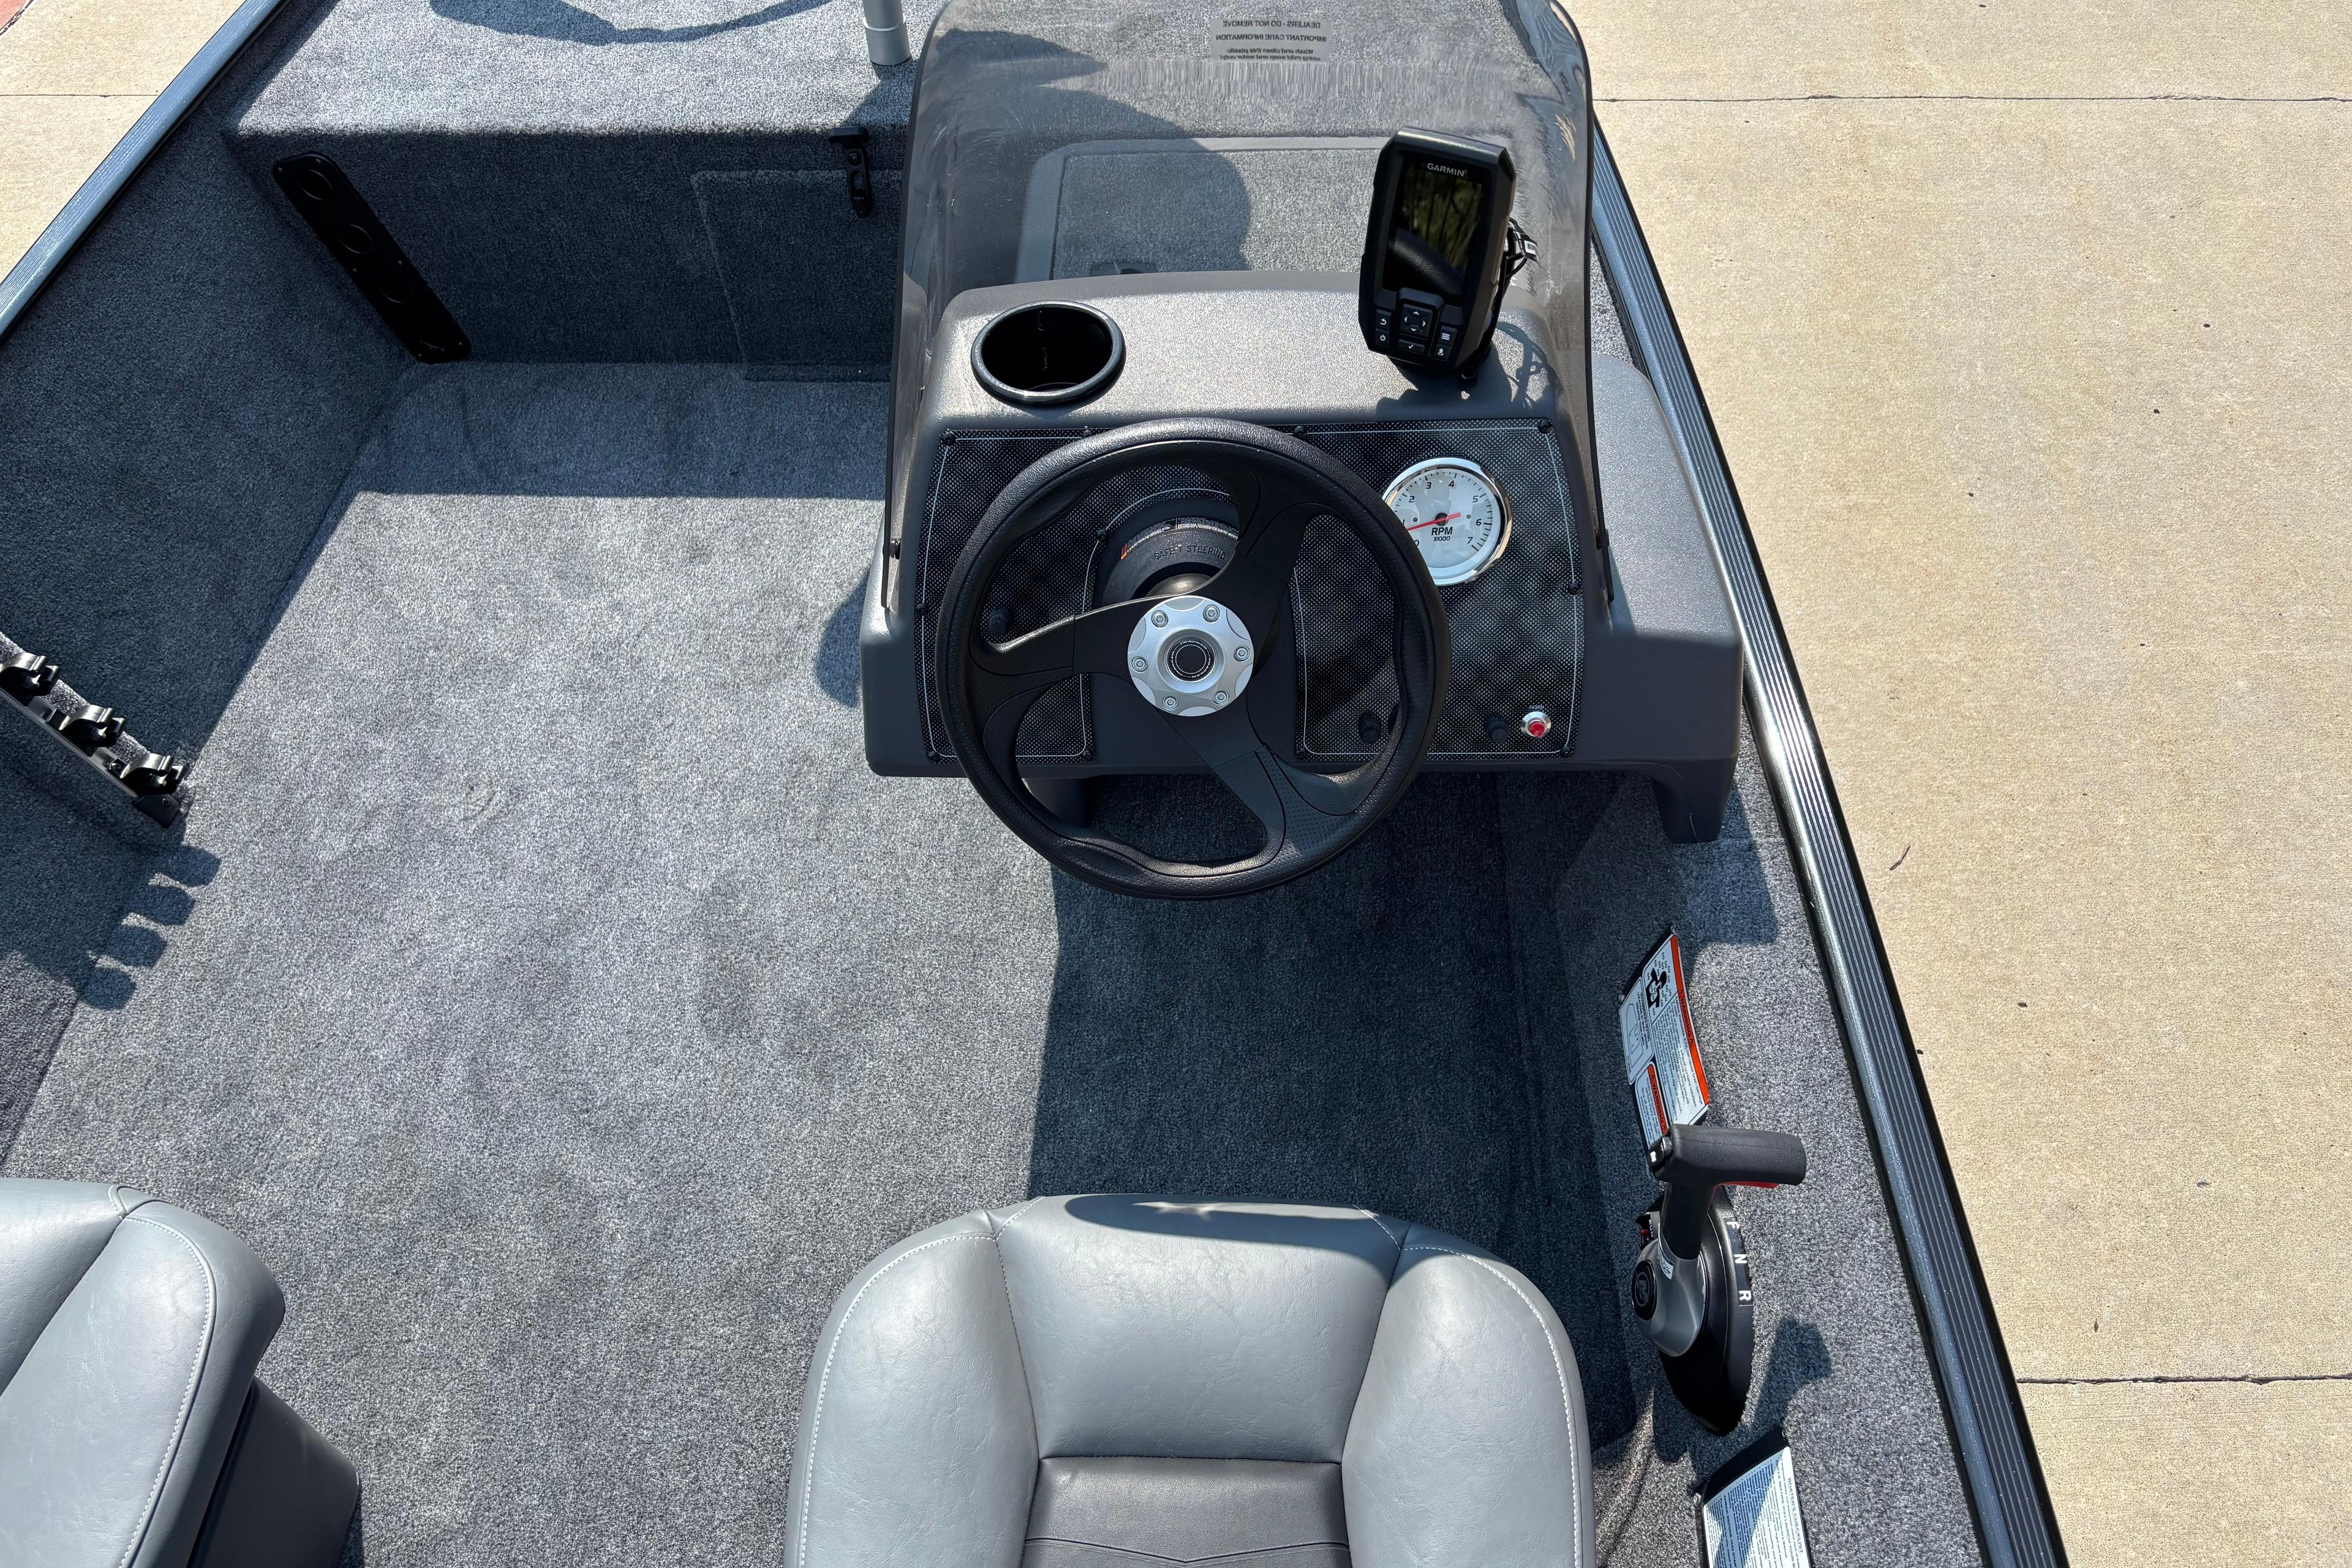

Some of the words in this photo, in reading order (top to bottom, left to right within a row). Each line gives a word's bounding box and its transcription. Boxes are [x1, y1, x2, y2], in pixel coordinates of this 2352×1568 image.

[1427, 163, 1464, 176] GARMIN
[1431, 526, 1453, 535] RPM
[1187, 545, 1226, 559] STEERING
[1727, 1221, 1740, 1229] F
[1734, 1254, 1747, 1264] N
[1739, 1291, 1752, 1300] R
[1792, 1513, 1804, 1553] CHECKLIST
